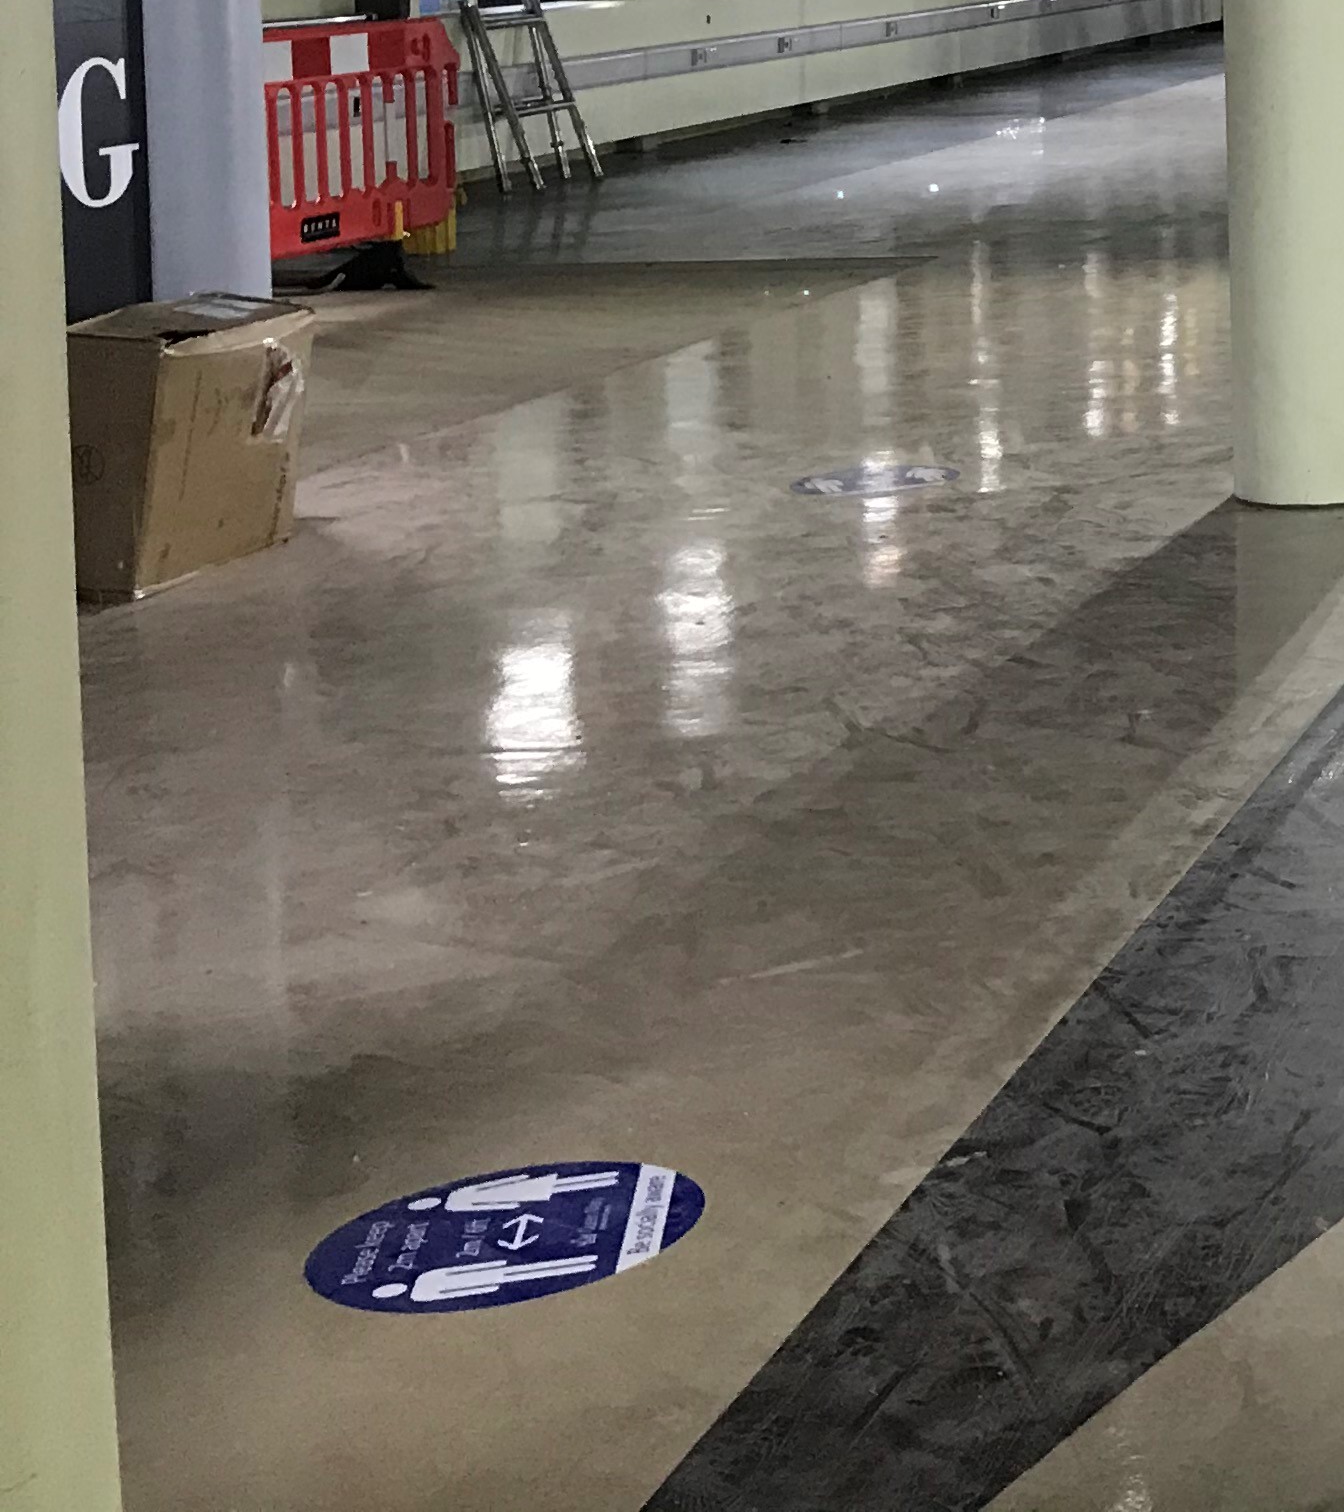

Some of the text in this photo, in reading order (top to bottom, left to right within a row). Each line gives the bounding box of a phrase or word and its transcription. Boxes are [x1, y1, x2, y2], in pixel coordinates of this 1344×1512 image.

[58, 55, 140, 210] G
[635, 1203, 665, 1241] socially
[341, 1220, 395, 1286] Please keep
[388, 1221, 430, 1272] 2m apart
[455, 1239, 482, 1259] 2m
[626, 1239, 652, 1256] Be
